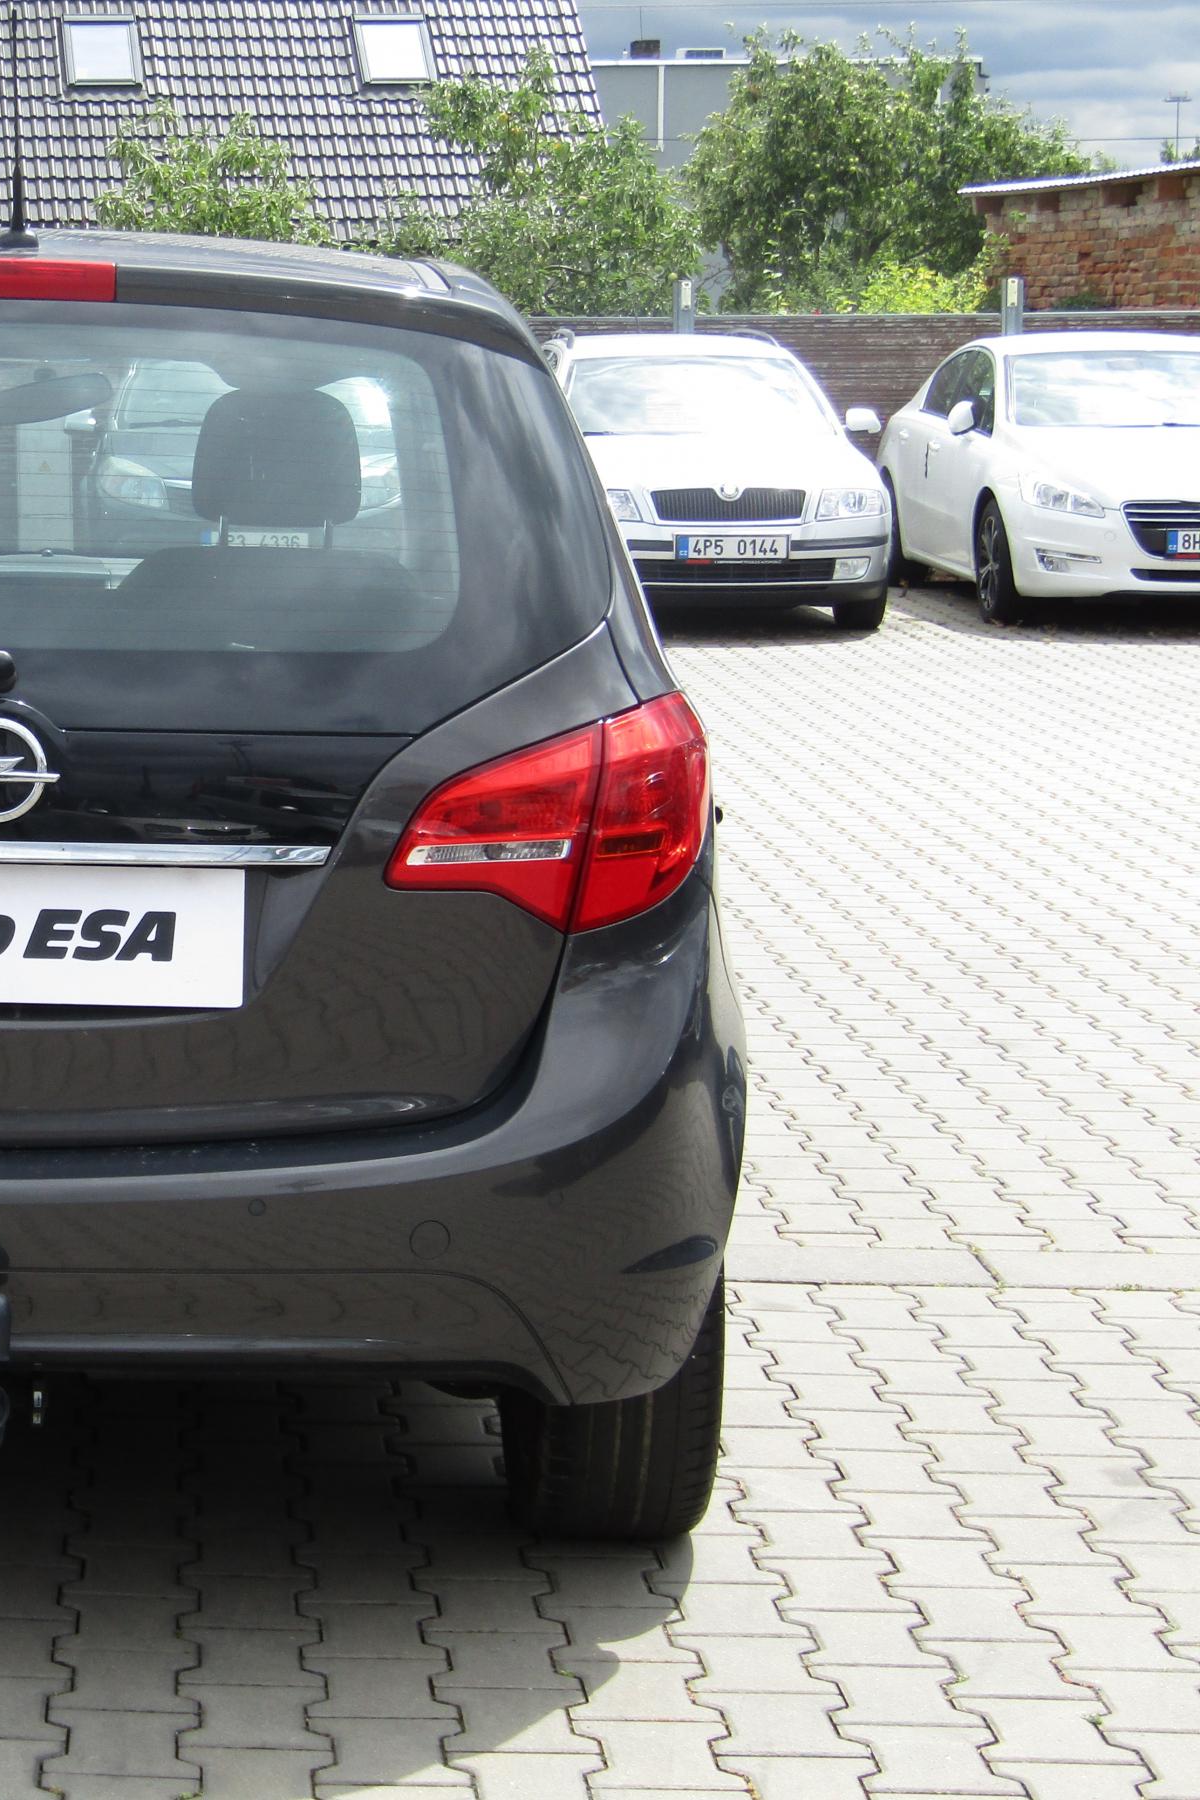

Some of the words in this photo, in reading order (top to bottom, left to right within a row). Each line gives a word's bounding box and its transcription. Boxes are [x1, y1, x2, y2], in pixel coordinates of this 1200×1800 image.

[692, 539, 724, 556] 4P5
[737, 539, 779, 556] 0144
[22, 908, 177, 962] ESA
